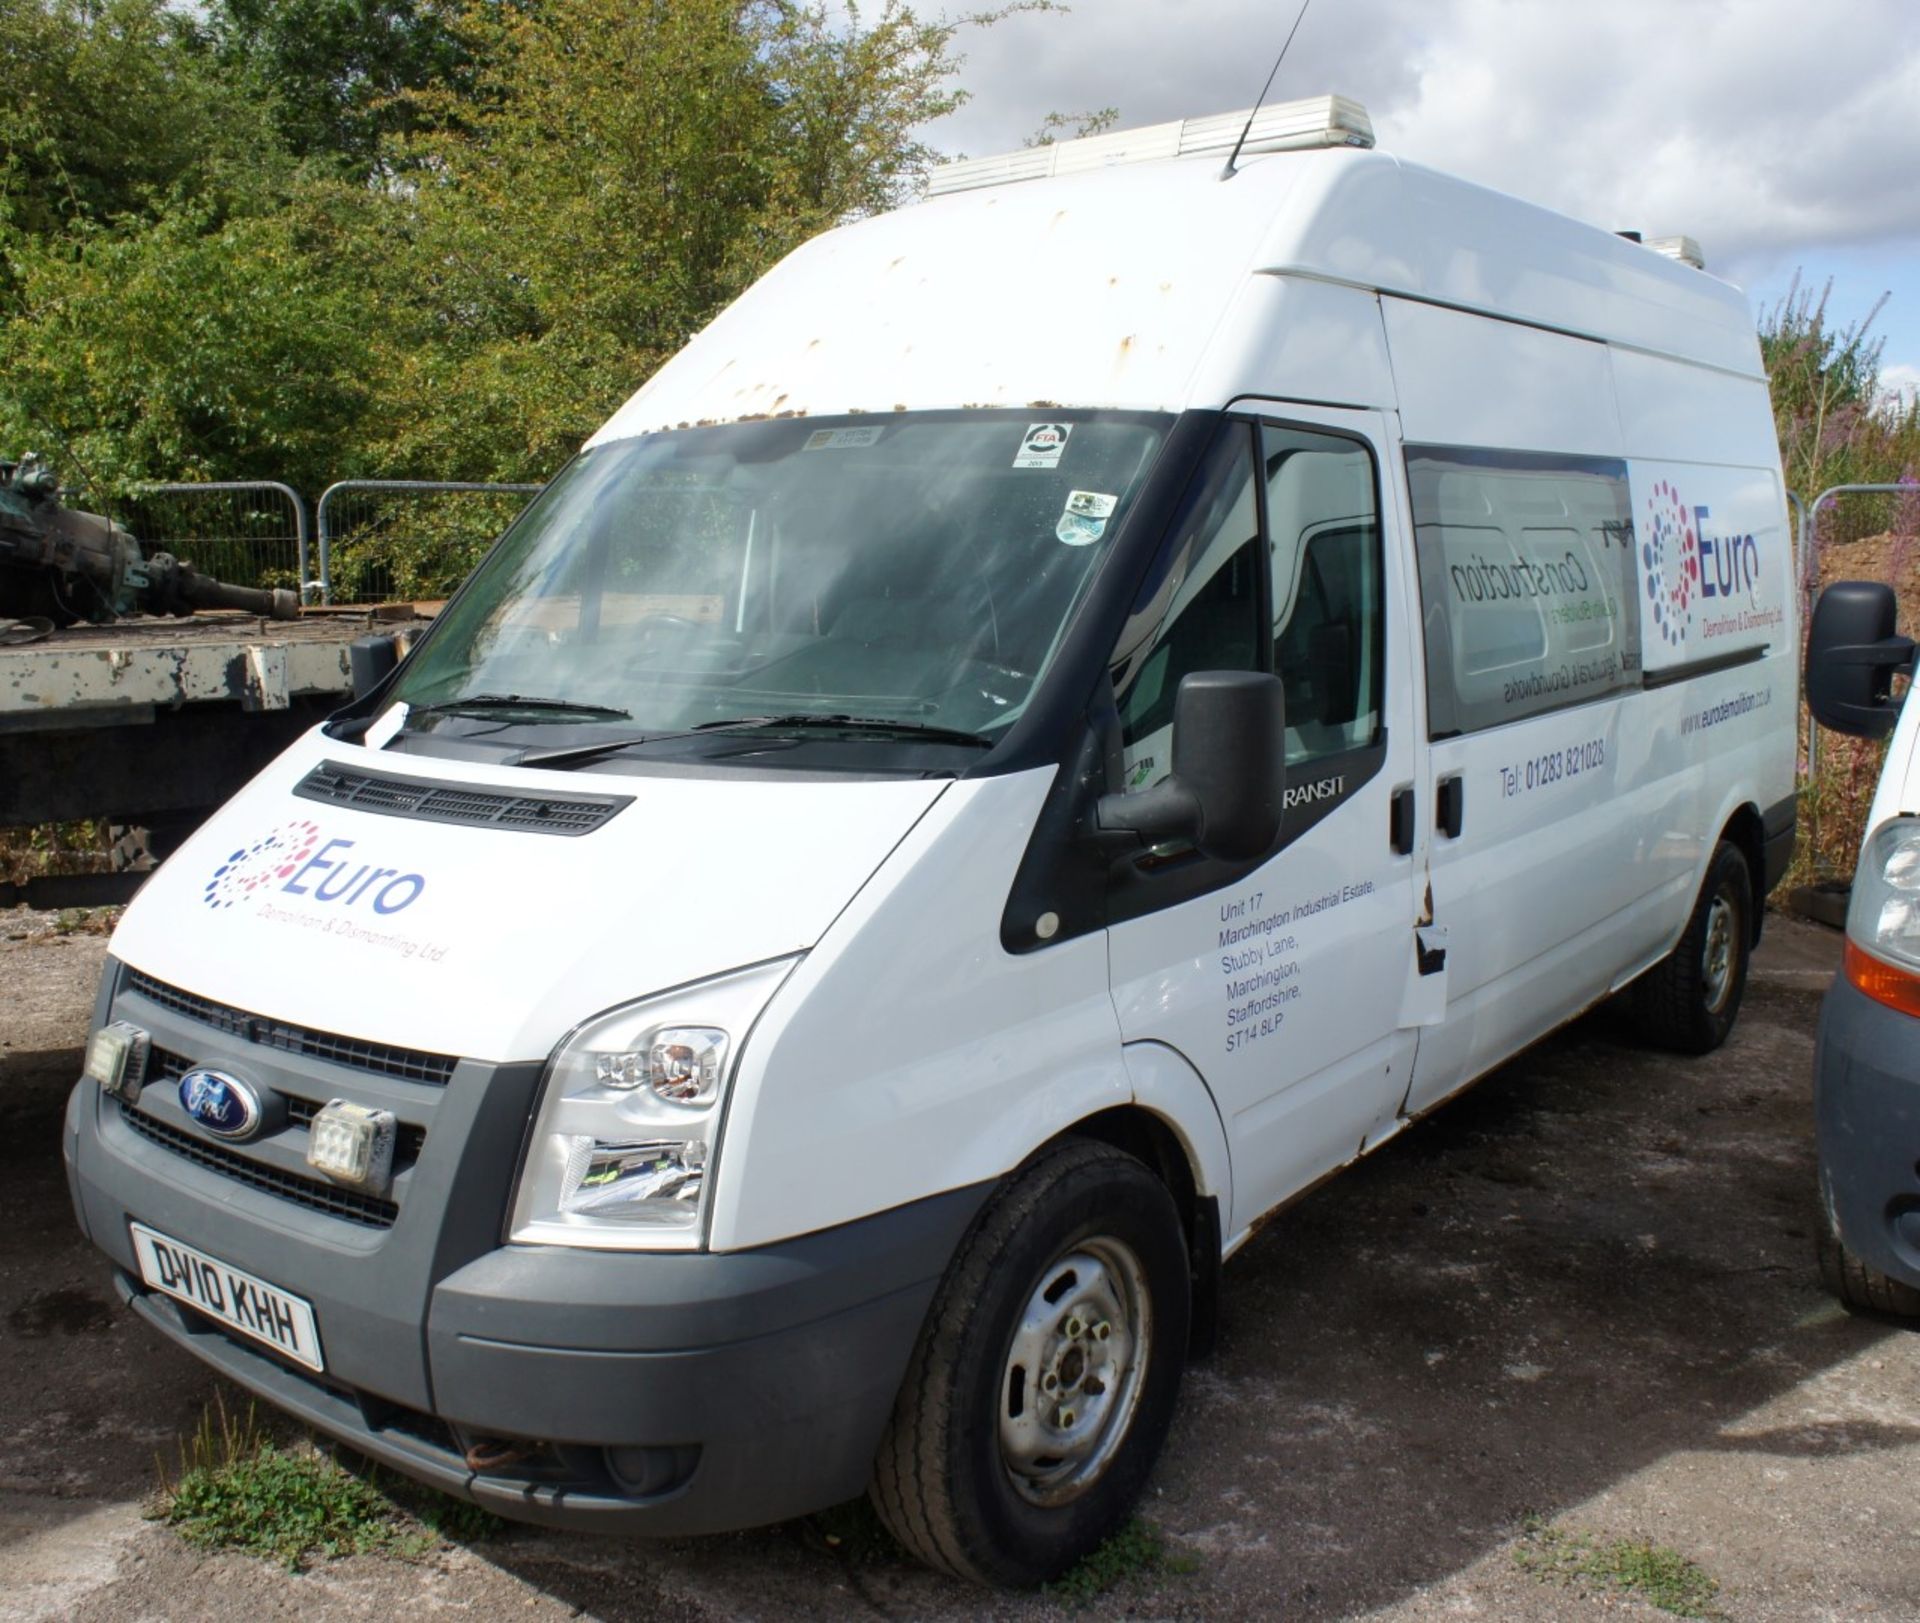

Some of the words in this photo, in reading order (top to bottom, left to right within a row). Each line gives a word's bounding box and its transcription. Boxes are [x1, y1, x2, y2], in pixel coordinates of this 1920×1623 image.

[1035, 434, 1057, 442] FTA
[1694, 506, 1759, 598] Euro
[1500, 764, 1522, 798] Tel:
[1526, 751, 1562, 790] 01283
[1566, 738, 1604, 776] 821028
[1282, 775, 1346, 809] RANSIT
[281, 839, 425, 915] Euro
[322, 917, 336, 932] &
[1219, 911, 1290, 948] Marchington
[1292, 890, 1341, 921] Industrial
[1342, 880, 1375, 903] Estate,
[1220, 900, 1245, 922] Unit
[1249, 892, 1263, 912] 17
[1221, 949, 1263, 975] Stubby
[1266, 936, 1299, 957] Lane,
[1226, 960, 1300, 1001] Marchington,
[1227, 985, 1301, 1026] Staffordshire,
[1225, 1027, 1257, 1052] ST14
[1261, 1012, 1284, 1037] 8LP
[187, 1076, 232, 1122] Ford
[151, 1240, 227, 1311] DV10
[229, 1276, 300, 1350] KHH
